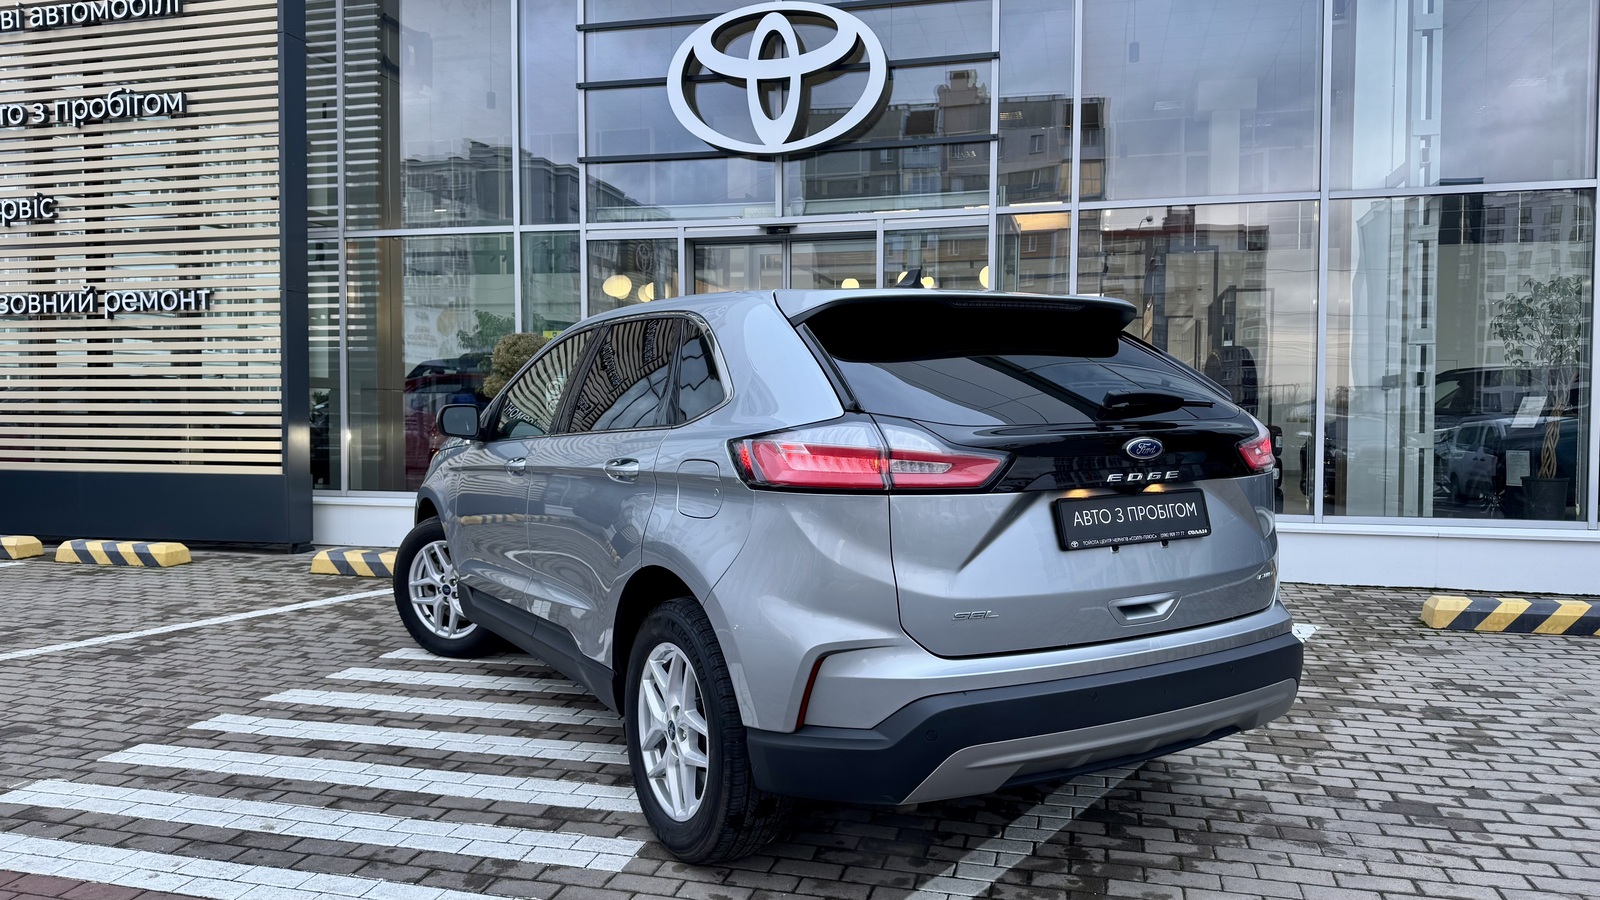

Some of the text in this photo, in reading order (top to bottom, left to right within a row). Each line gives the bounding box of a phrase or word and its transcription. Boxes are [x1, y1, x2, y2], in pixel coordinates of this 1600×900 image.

[0, 2, 20, 30] ві
[0, 87, 183, 127] то з пробігом
[0, 192, 54, 227] рвіс
[0, 285, 210, 319] зовний ремонт
[1136, 442, 1156, 455] Ford
[1106, 470, 1179, 482] EDGE
[1073, 501, 1198, 527] АВТО З ПРОБІГОМ
[951, 610, 999, 621] SEL
